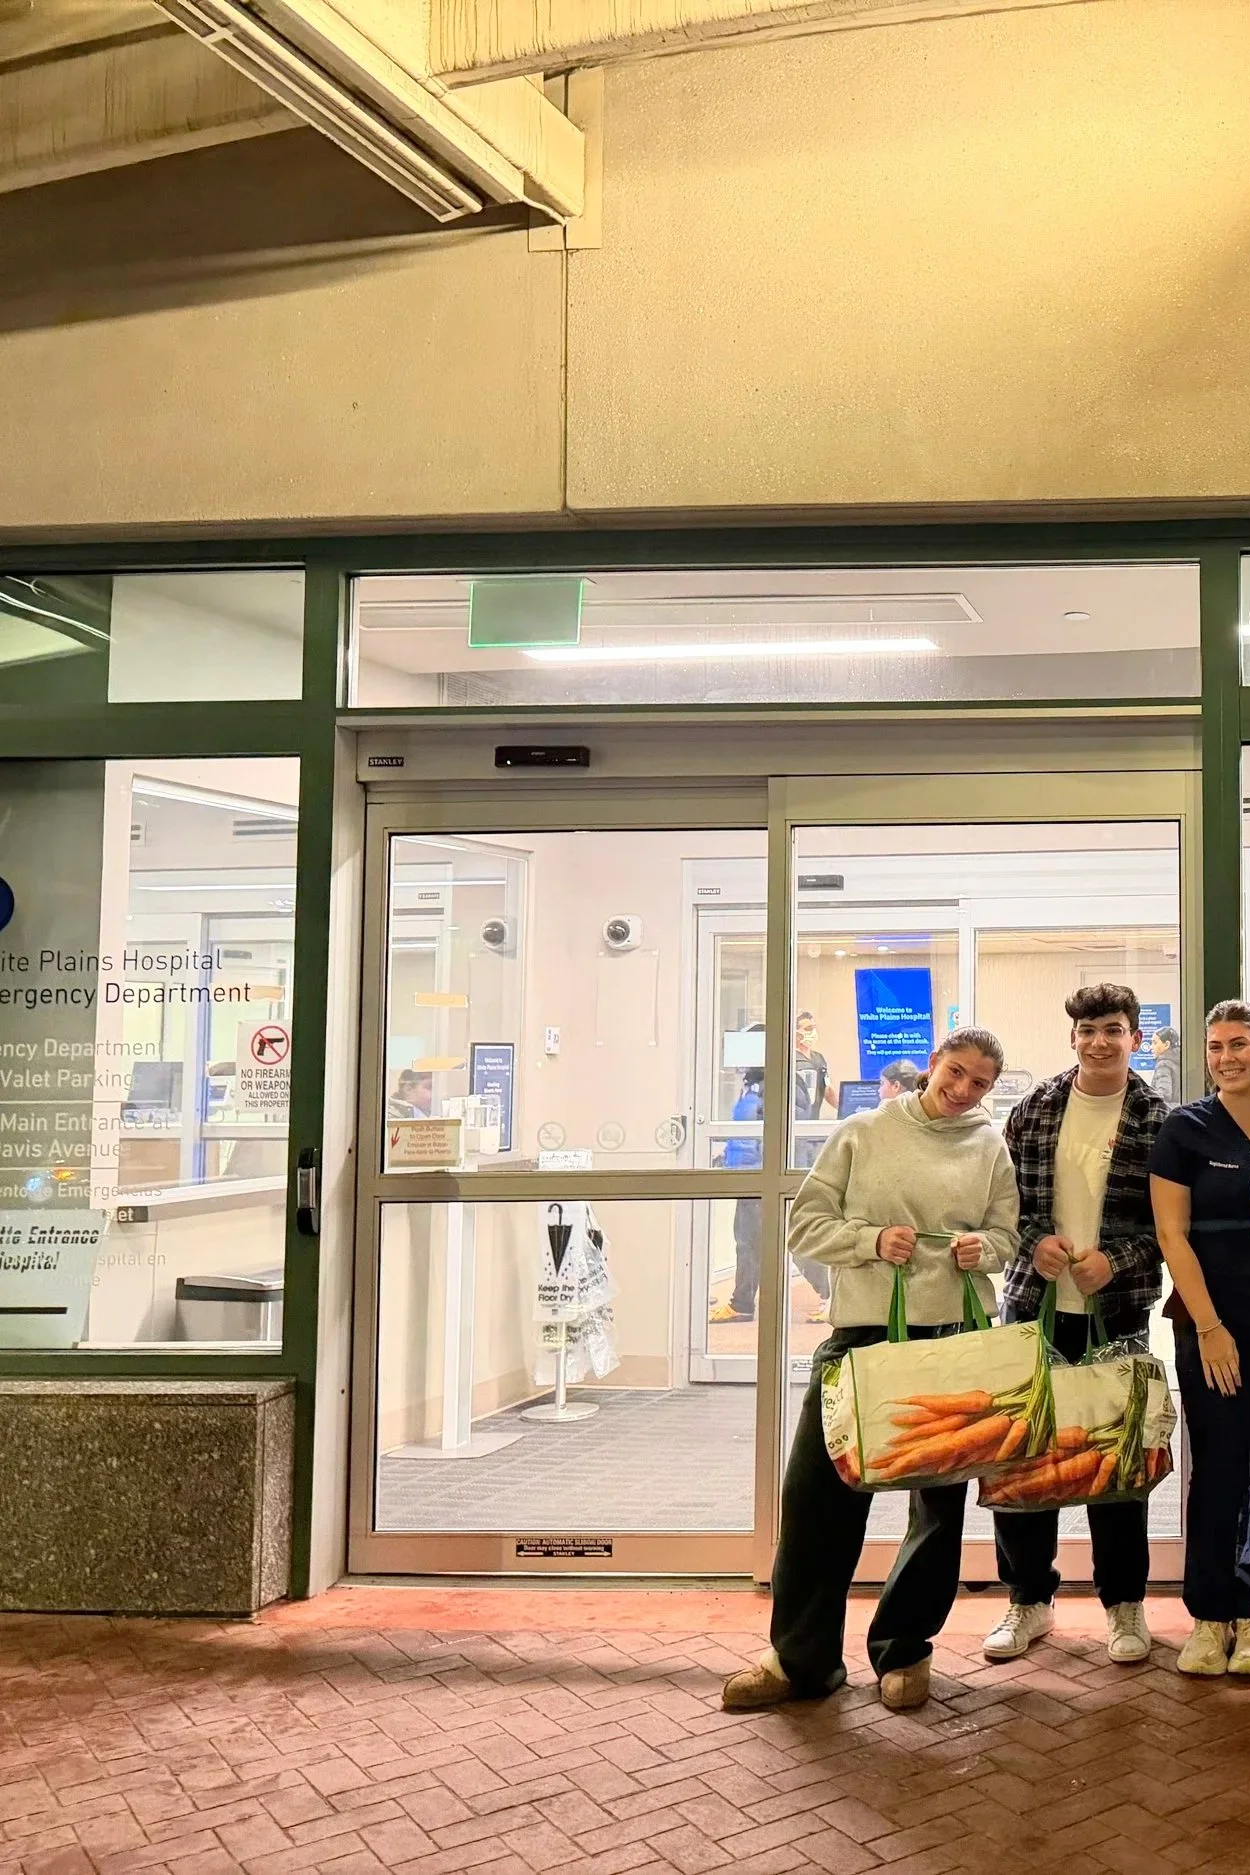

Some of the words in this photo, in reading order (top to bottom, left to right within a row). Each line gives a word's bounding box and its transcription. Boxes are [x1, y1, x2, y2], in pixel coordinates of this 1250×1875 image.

[369, 758, 404, 766] STANLEY
[40, 950, 113, 972] Plains
[123, 949, 223, 975] Hospital
[106, 982, 251, 1008] Department
[44, 1038, 162, 1059] Department
[0, 1069, 50, 1088] Valet
[57, 1069, 134, 1092] Parking
[241, 1069, 253, 1078] NO
[255, 1069, 291, 1079] FIREARM
[241, 1081, 253, 1090] OR
[255, 1081, 290, 1091] WEAPON
[0, 1113, 47, 1131] Main
[55, 1112, 144, 1131] Entrance
[0, 1140, 42, 1157] avis
[48, 1140, 121, 1157] Avenue
[560, 1294, 574, 1302] Dry
